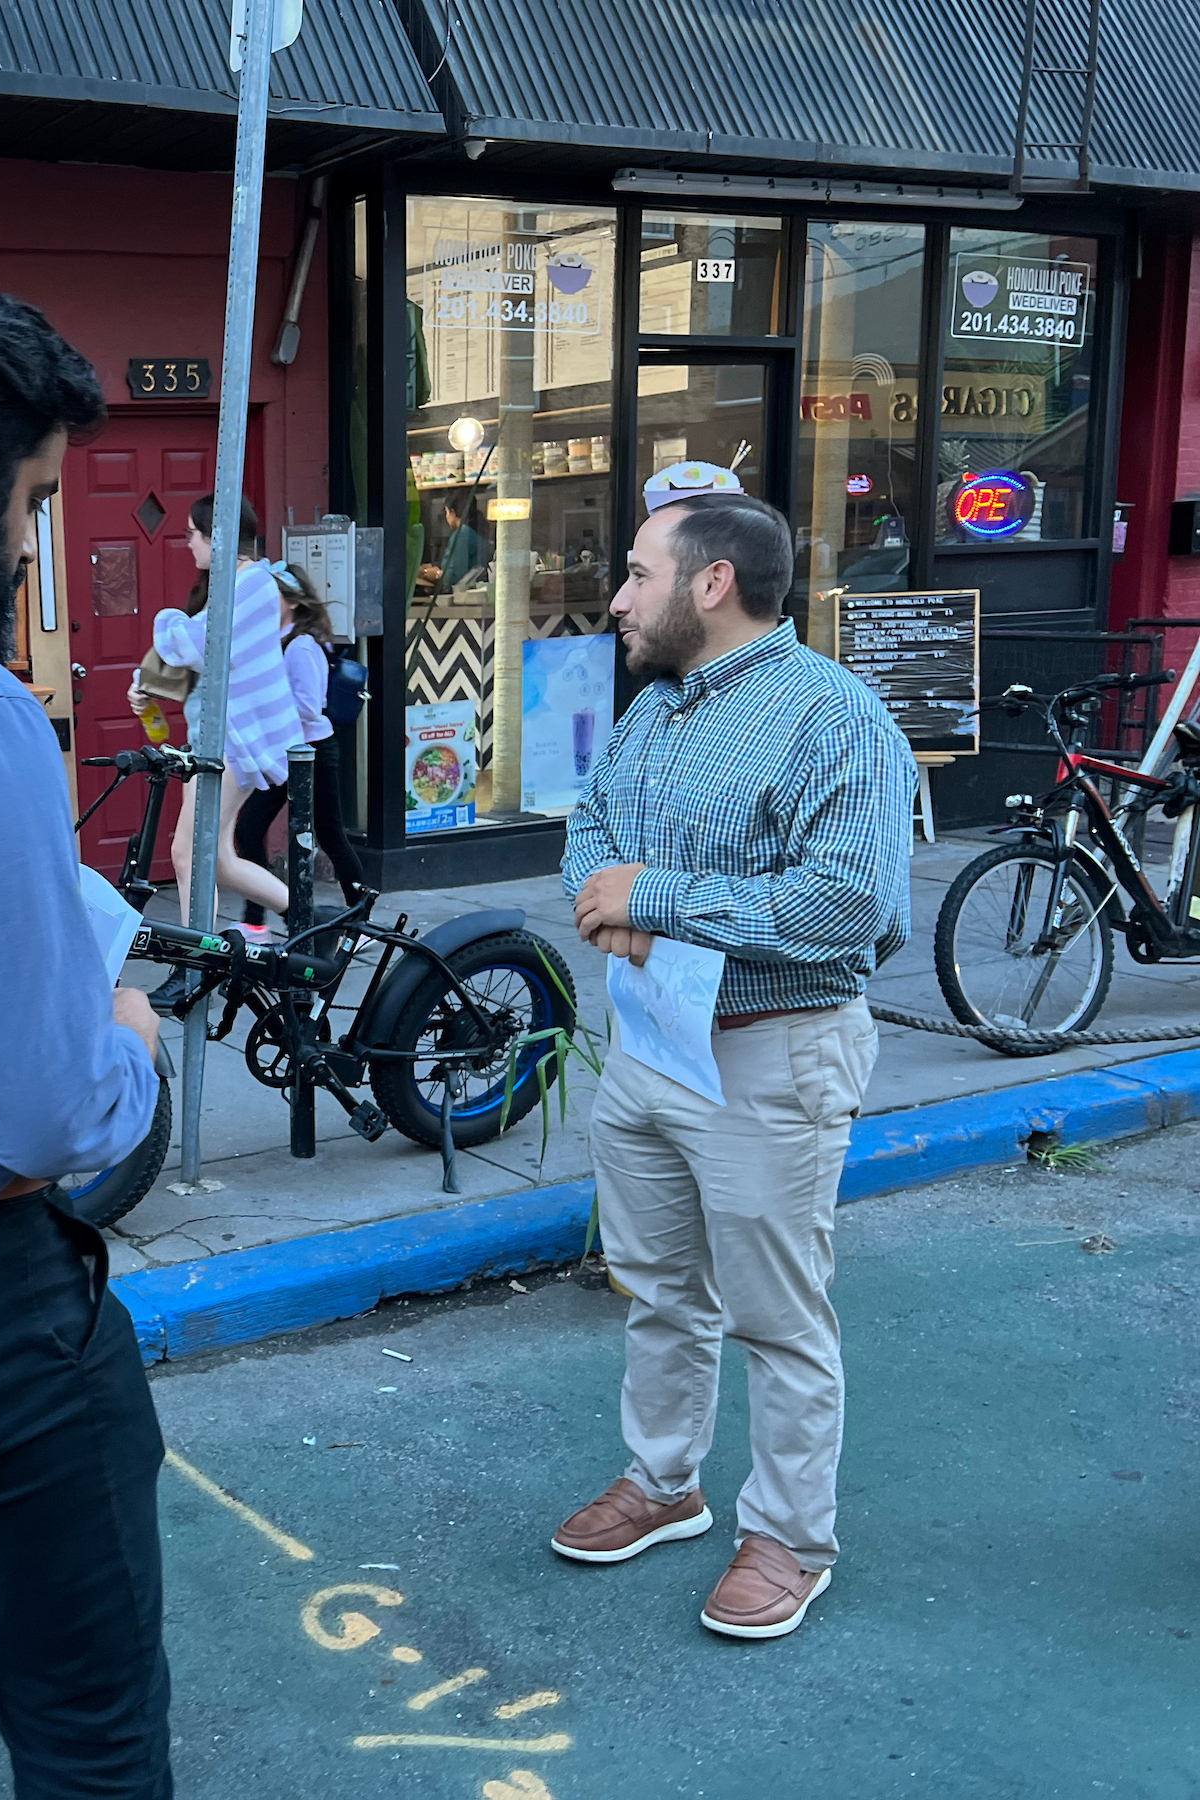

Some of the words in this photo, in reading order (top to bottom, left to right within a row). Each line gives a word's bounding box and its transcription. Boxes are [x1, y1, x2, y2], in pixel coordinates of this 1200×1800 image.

[507, 242, 537, 271] POKE
[700, 262, 732, 279] 337
[1006, 266, 1057, 294] HONOLULU
[1059, 271, 1083, 296] POKE
[437, 297, 588, 325] 201.434.3840
[1011, 294, 1075, 312] WEDELIVER
[960, 311, 1076, 340] 201.434.3840
[141, 363, 200, 392] 335
